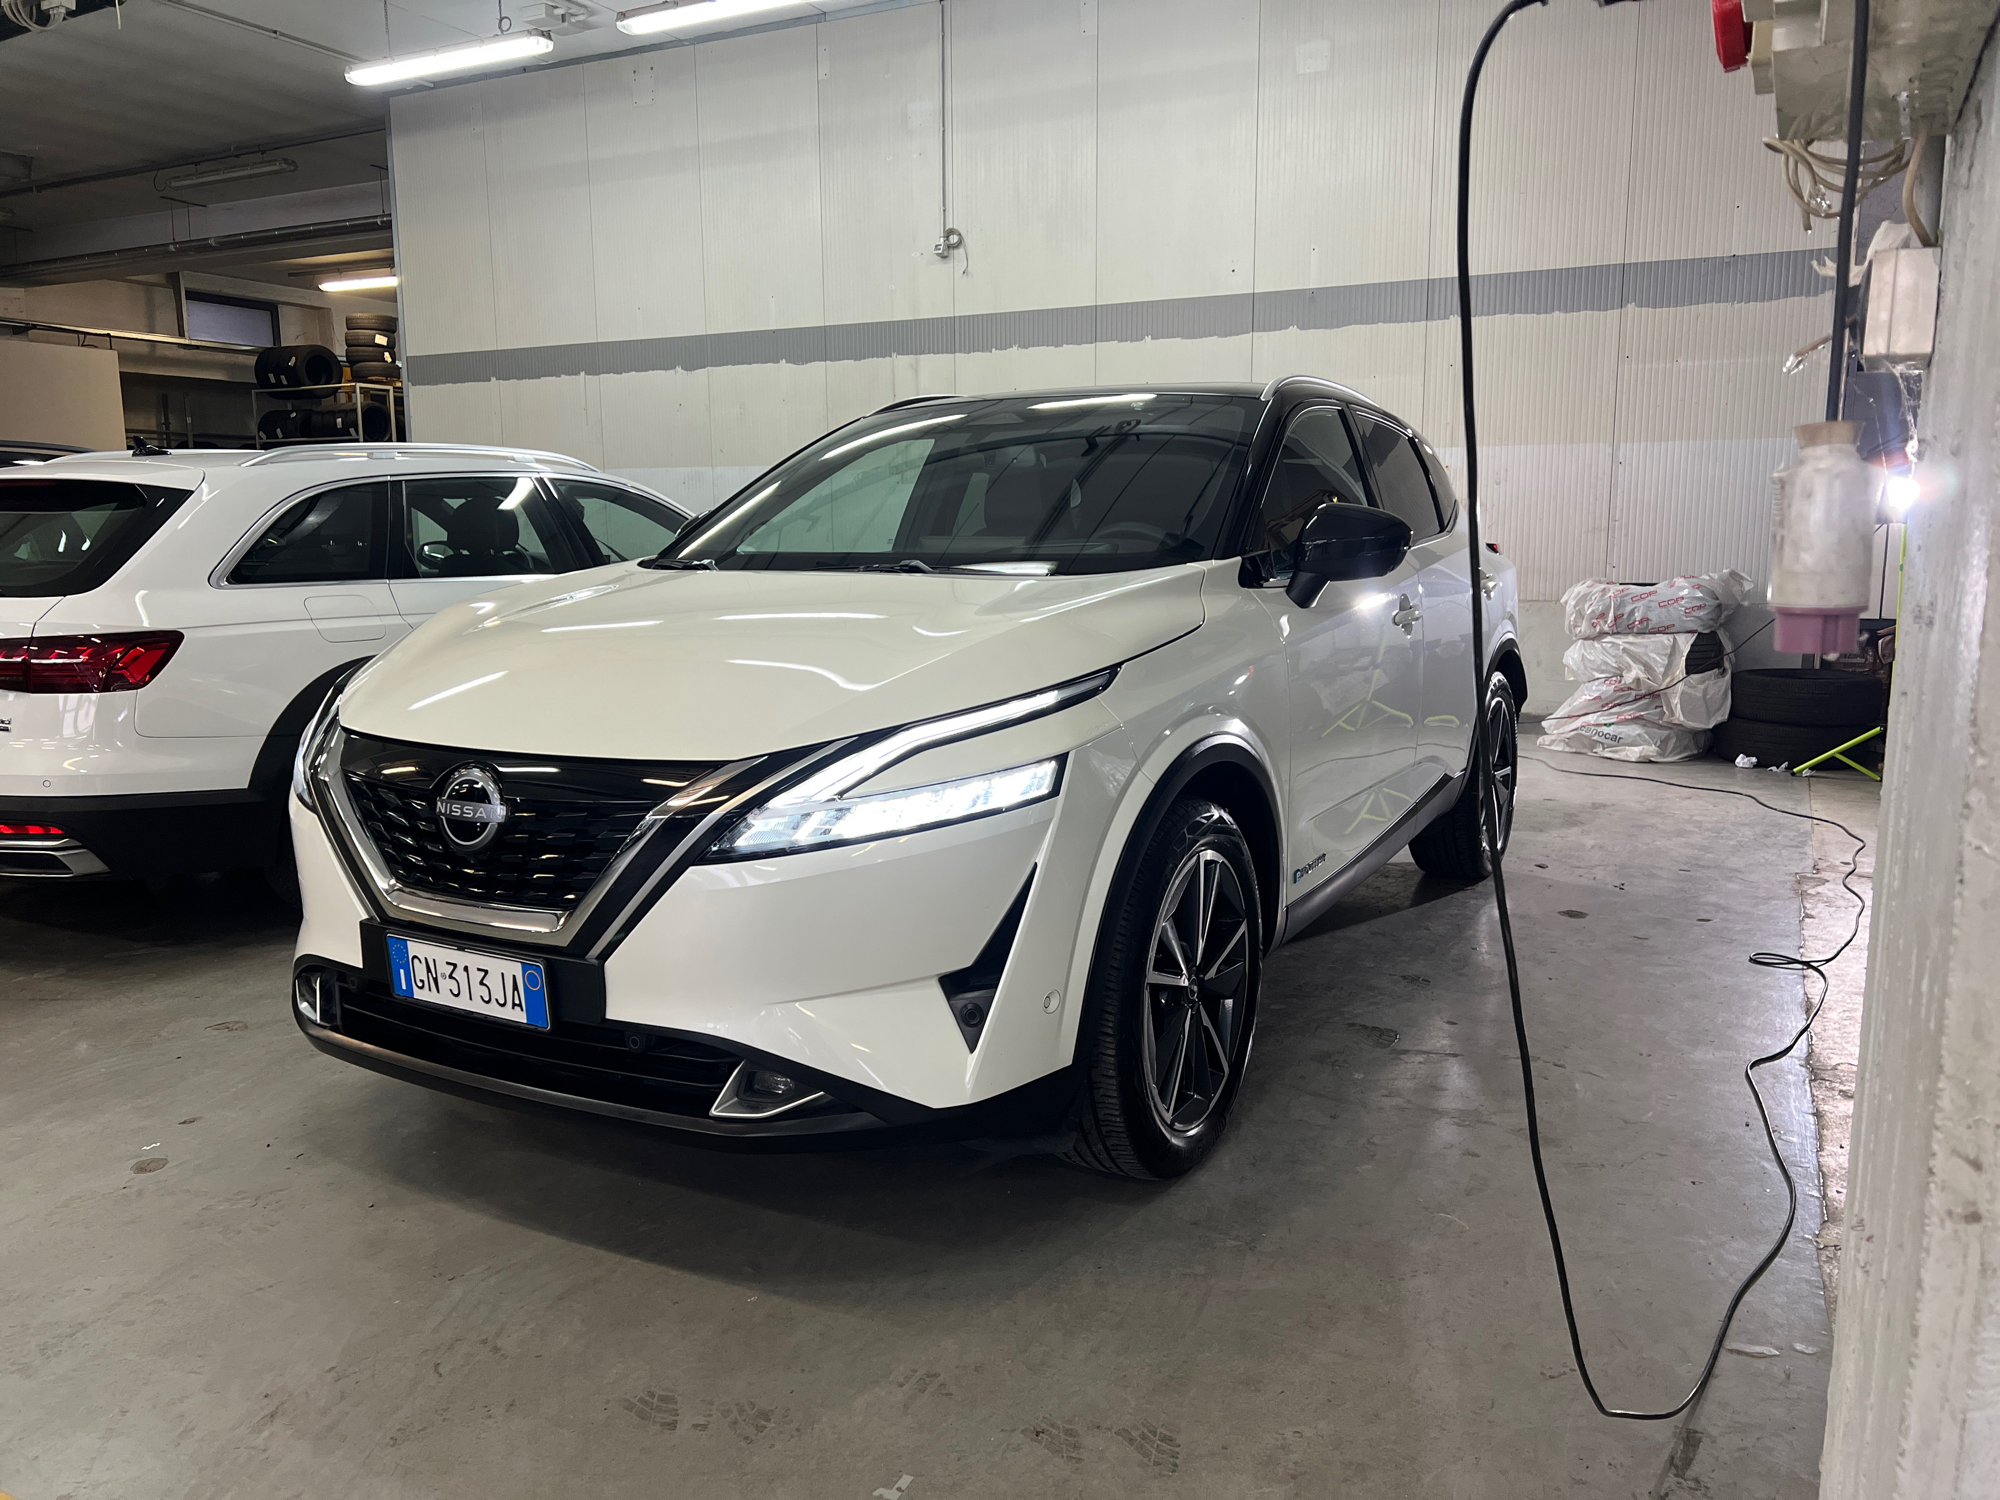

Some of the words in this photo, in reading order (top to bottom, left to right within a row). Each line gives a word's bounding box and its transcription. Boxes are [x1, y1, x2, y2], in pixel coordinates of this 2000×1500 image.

[1630, 590, 1658, 603] CDP
[1658, 596, 1685, 608] CDP
[437, 801, 506, 820] NISSAN
